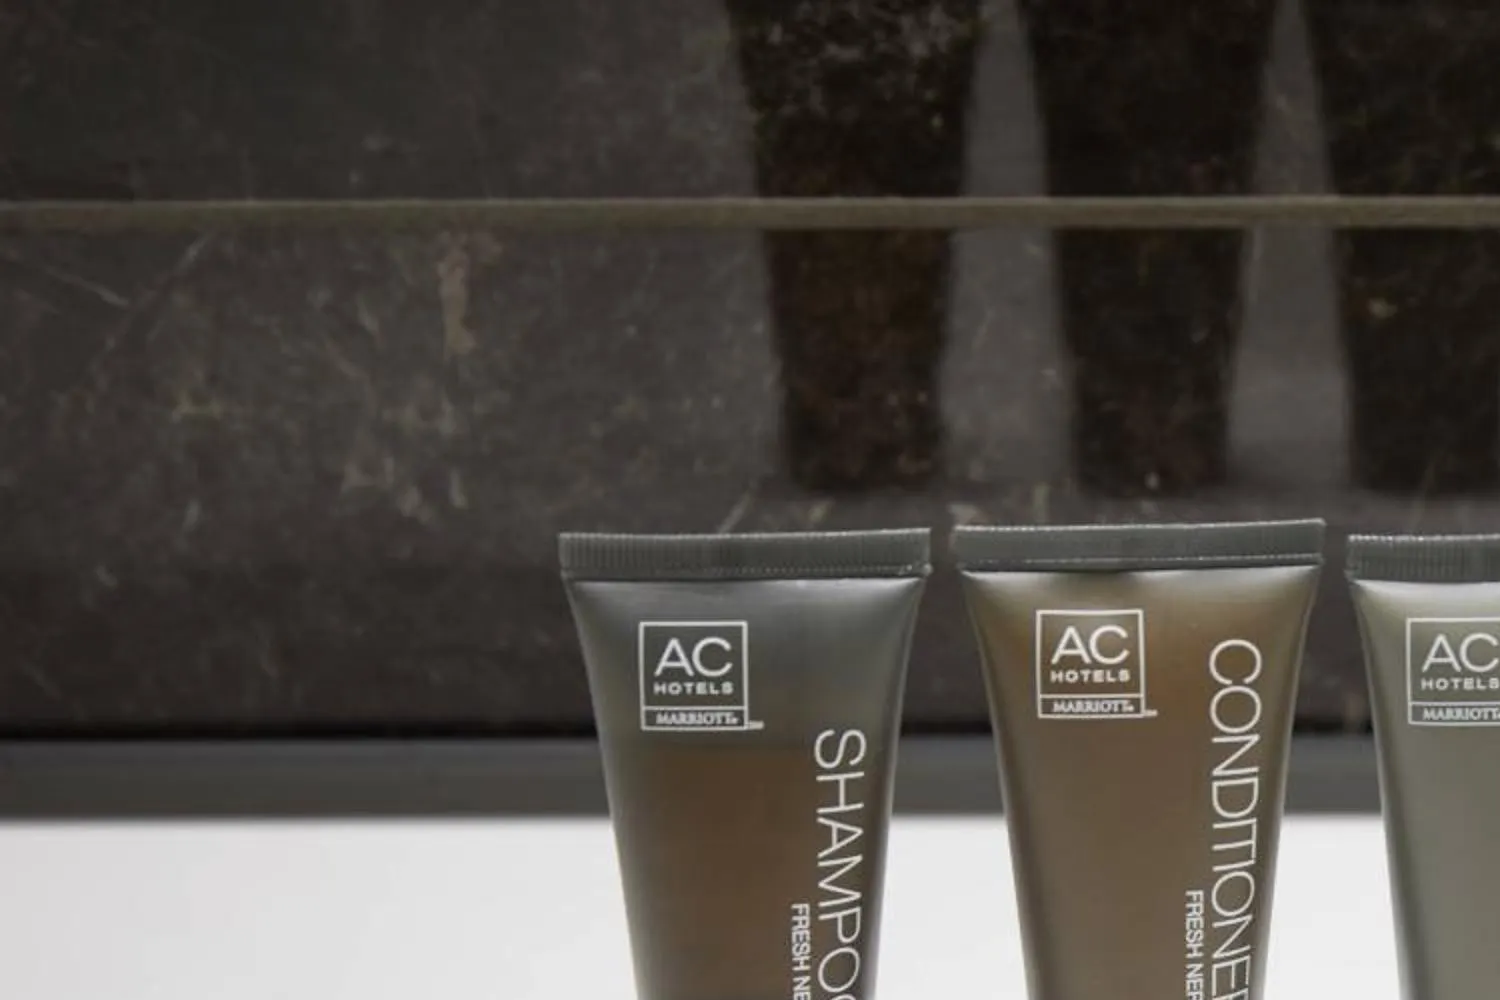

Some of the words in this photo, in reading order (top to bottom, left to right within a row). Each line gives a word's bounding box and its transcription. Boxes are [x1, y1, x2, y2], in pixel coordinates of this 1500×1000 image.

[654, 637, 733, 677] AC
[1051, 625, 1130, 665] AC
[1422, 633, 1499, 673] AC
[653, 681, 734, 695] HOTELS
[1050, 669, 1130, 683] HOTELS
[1421, 677, 1500, 691] HOTELS
[791, 903, 811, 971] FRESH
[1185, 890, 1204, 957] FRESH
